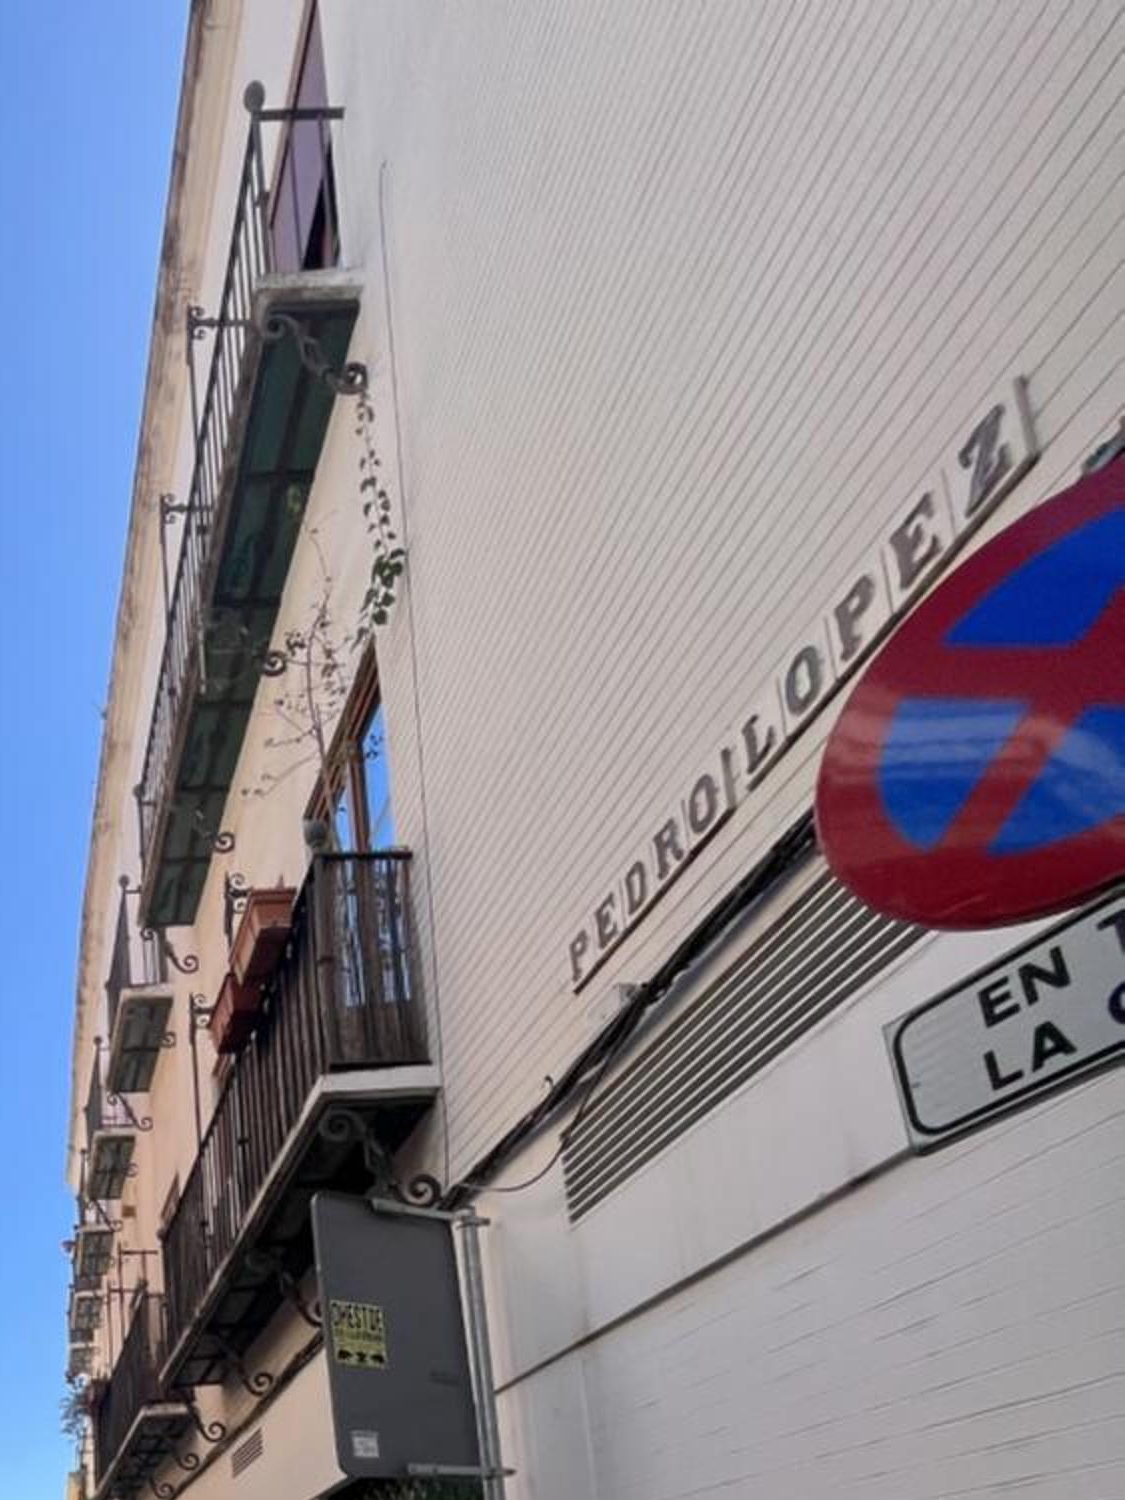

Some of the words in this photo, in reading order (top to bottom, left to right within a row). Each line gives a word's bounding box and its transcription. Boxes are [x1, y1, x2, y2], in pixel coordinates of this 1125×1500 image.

[569, 773, 718, 981] PEDRO
[742, 403, 1014, 775] LOPEZ
[978, 946, 1071, 1028] EN
[984, 1021, 1078, 1090] LA
